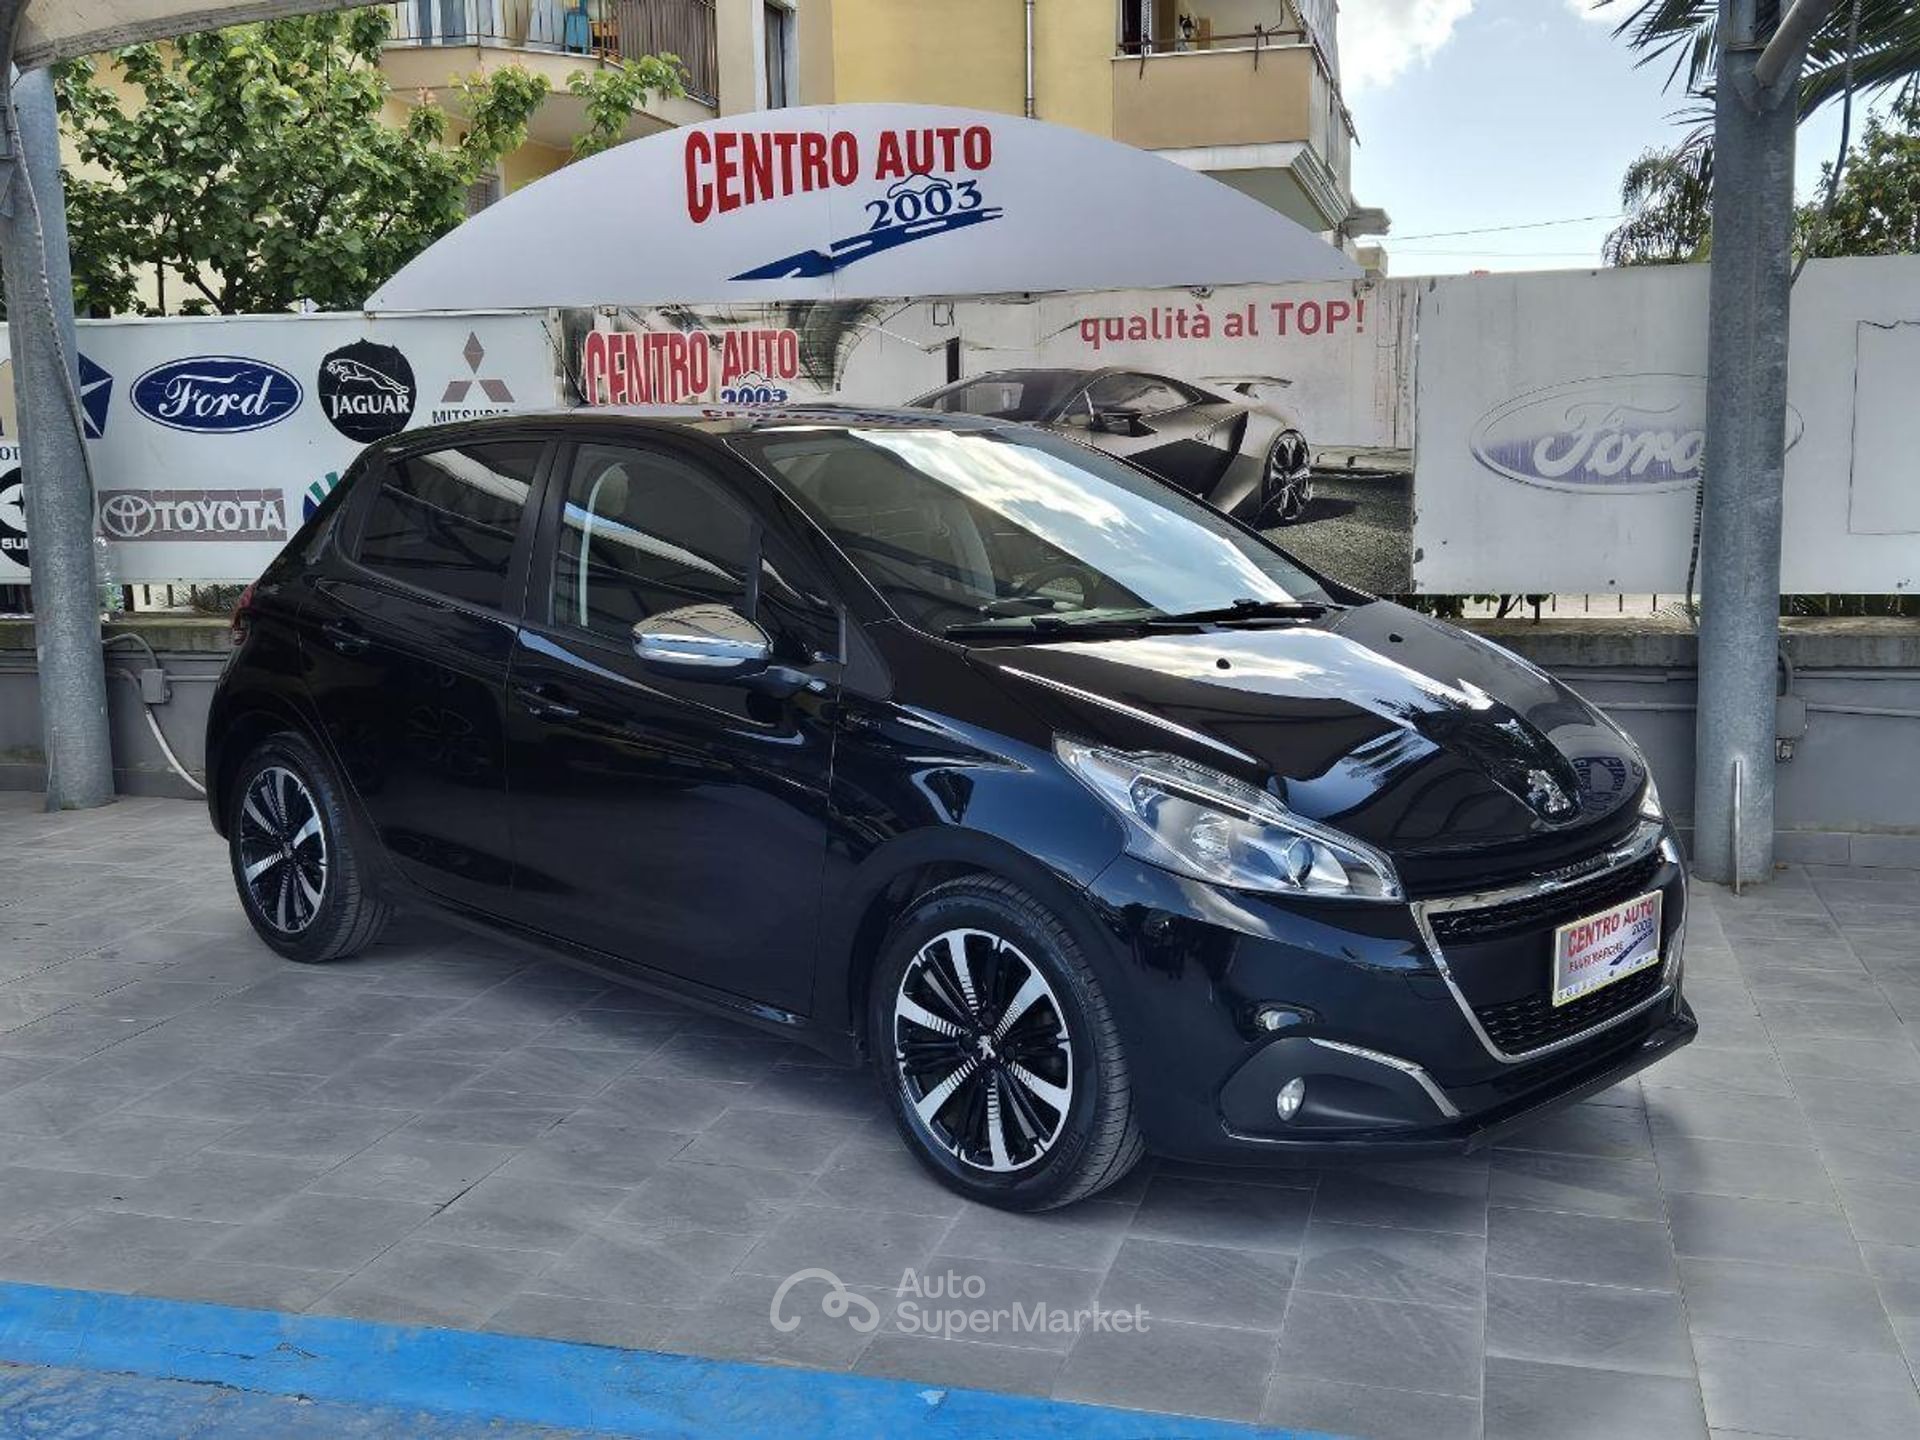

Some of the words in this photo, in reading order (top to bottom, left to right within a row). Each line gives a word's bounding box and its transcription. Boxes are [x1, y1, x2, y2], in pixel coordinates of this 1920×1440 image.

[685, 130, 859, 223] CENTRO
[875, 126, 993, 180] AUTO
[864, 180, 983, 230] 2003
[1079, 303, 1211, 350] qualità
[1223, 304, 1259, 337] al
[1271, 299, 1365, 336] TOP!
[585, 330, 710, 405] CENTRO
[721, 329, 799, 387] AUTO
[158, 373, 275, 418] Ford
[331, 394, 411, 420] JAGUAR
[719, 387, 789, 404] 2003
[153, 501, 287, 531] TOYOTA
[1567, 913, 1620, 957] CENTRO
[1622, 899, 1655, 927] AUTO
